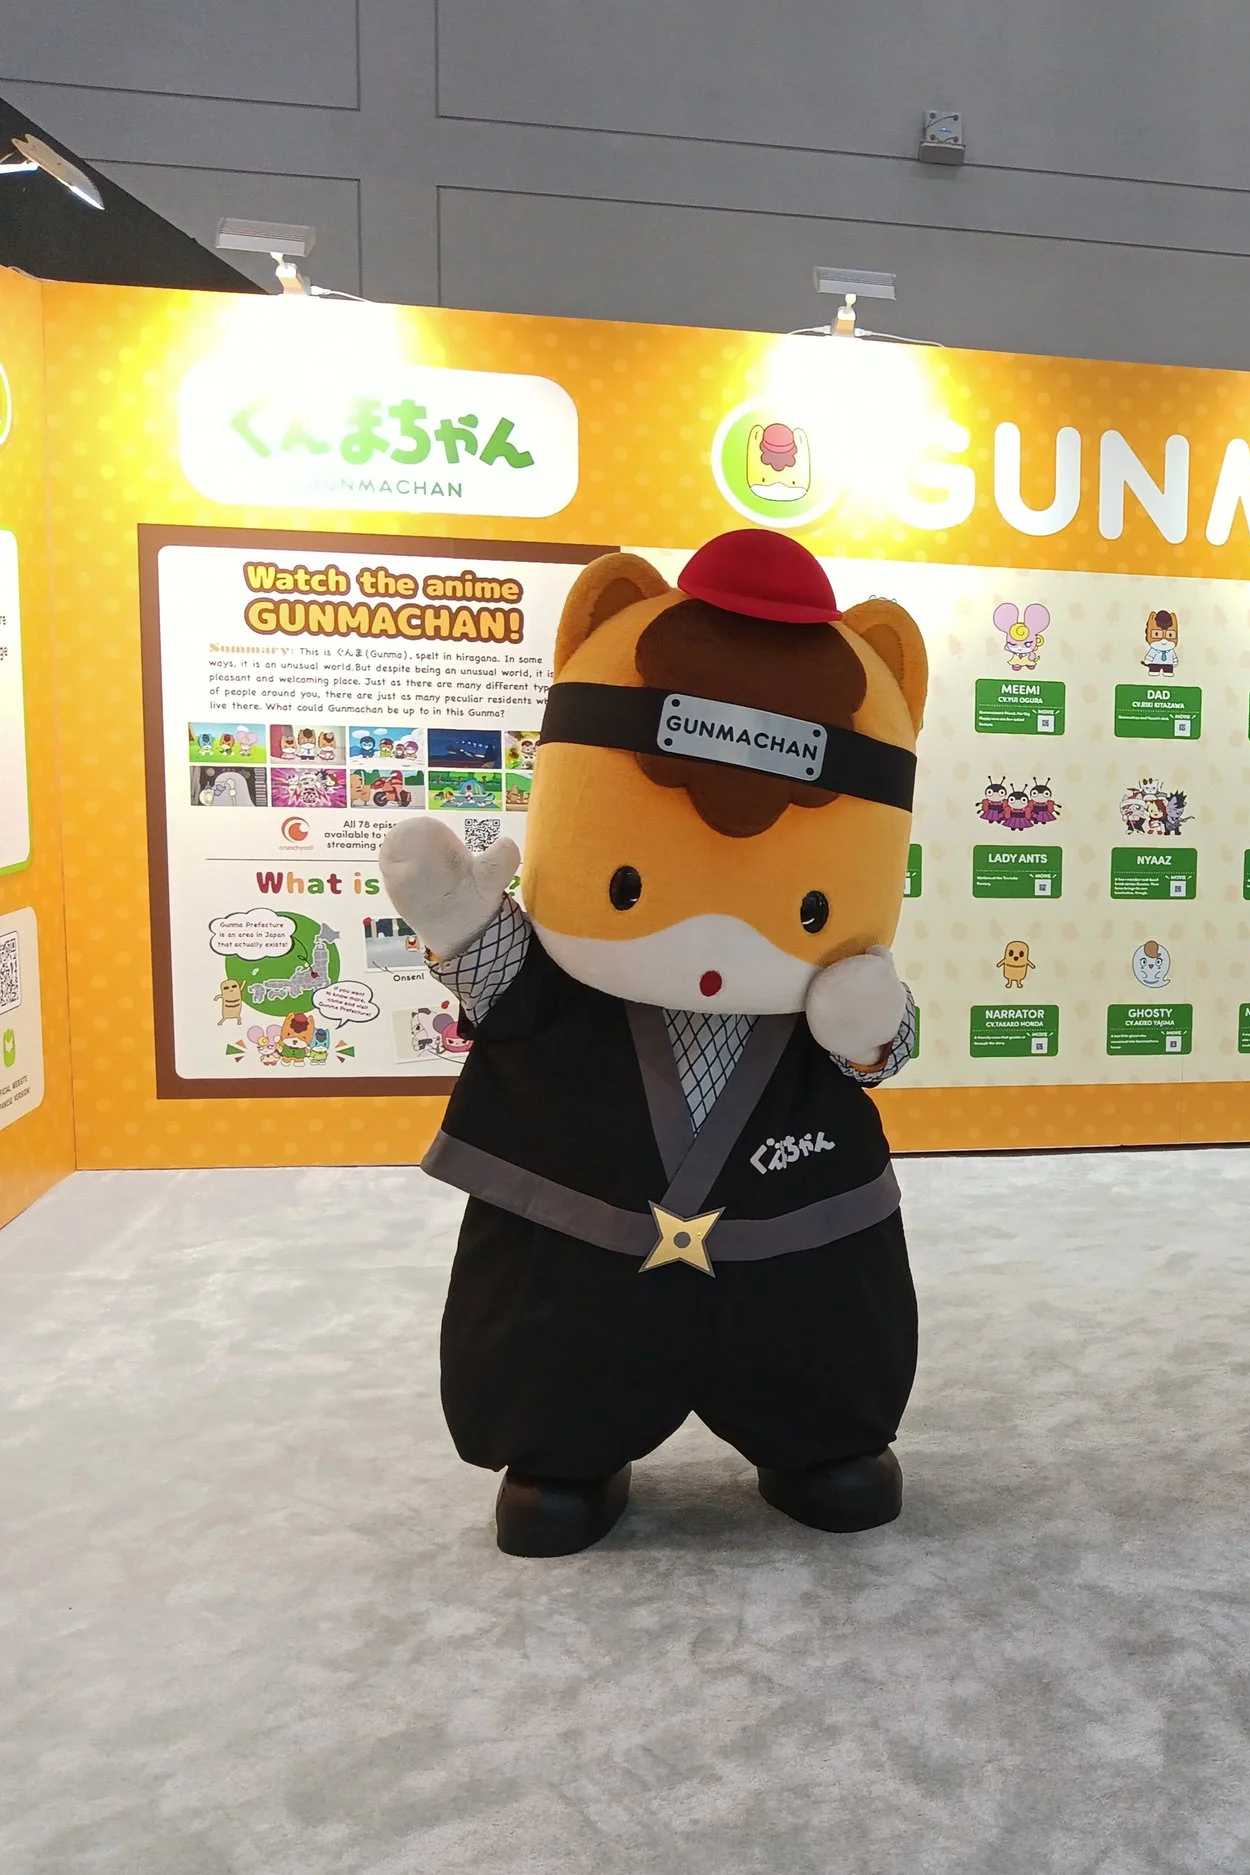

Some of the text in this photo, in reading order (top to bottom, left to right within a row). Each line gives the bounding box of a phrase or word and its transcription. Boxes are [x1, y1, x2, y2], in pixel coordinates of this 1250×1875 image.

[245, 563, 522, 602] Watch the anime
[246, 599, 522, 642] GUNMACHAN!
[300, 648, 320, 656] This
[324, 648, 331, 656] is
[416, 652, 439, 662] spelt
[443, 653, 452, 661] in
[456, 653, 500, 664] hiragana.
[504, 655, 515, 663] In
[518, 656, 543, 664] some
[241, 660, 247, 668] it
[252, 660, 260, 668] is
[281, 662, 318, 670] unusual
[376, 664, 411, 676] despite
[415, 666, 441, 676] being
[445, 667, 456, 675] an
[461, 667, 497, 676] unusual
[209, 673, 251, 682] pleasant
[256, 675, 274, 683] and
[279, 676, 329, 686] welcoming
[333, 677, 361, 686] place.
[365, 678, 386, 687] Just
[391, 679, 401, 687] as
[406, 679, 433, 688] there
[436, 681, 453, 689] are
[456, 682, 482, 692] many
[485, 682, 529, 692] different
[1001, 684, 1040, 695] MEEMI
[1147, 689, 1171, 700] DAD
[209, 687, 219, 695] of
[225, 687, 256, 698] people
[262, 689, 296, 698] around
[301, 691, 320, 700] you,
[326, 690, 352, 700] there
[377, 691, 396, 702] just
[401, 693, 411, 701] as
[415, 694, 440, 704] many
[445, 694, 483, 705] peculiar
[488, 696, 532, 706] residents
[210, 701, 505, 719] live there. What could Gunmachan be up to in this Gunma?
[666, 715, 818, 761] GUNMACHAN
[343, 820, 356, 828] All
[324, 831, 369, 839] available
[326, 841, 376, 851] streaming
[988, 853, 1048, 864] LADY ANTS
[1137, 855, 1172, 866] NYAAZ
[256, 871, 380, 895] What is
[265, 931, 286, 939] Japan
[234, 941, 262, 949] actually
[392, 972, 425, 983] Onsen!
[985, 1009, 1045, 1019] NARRATOR
[1128, 1008, 1173, 1018] GHOSTY
